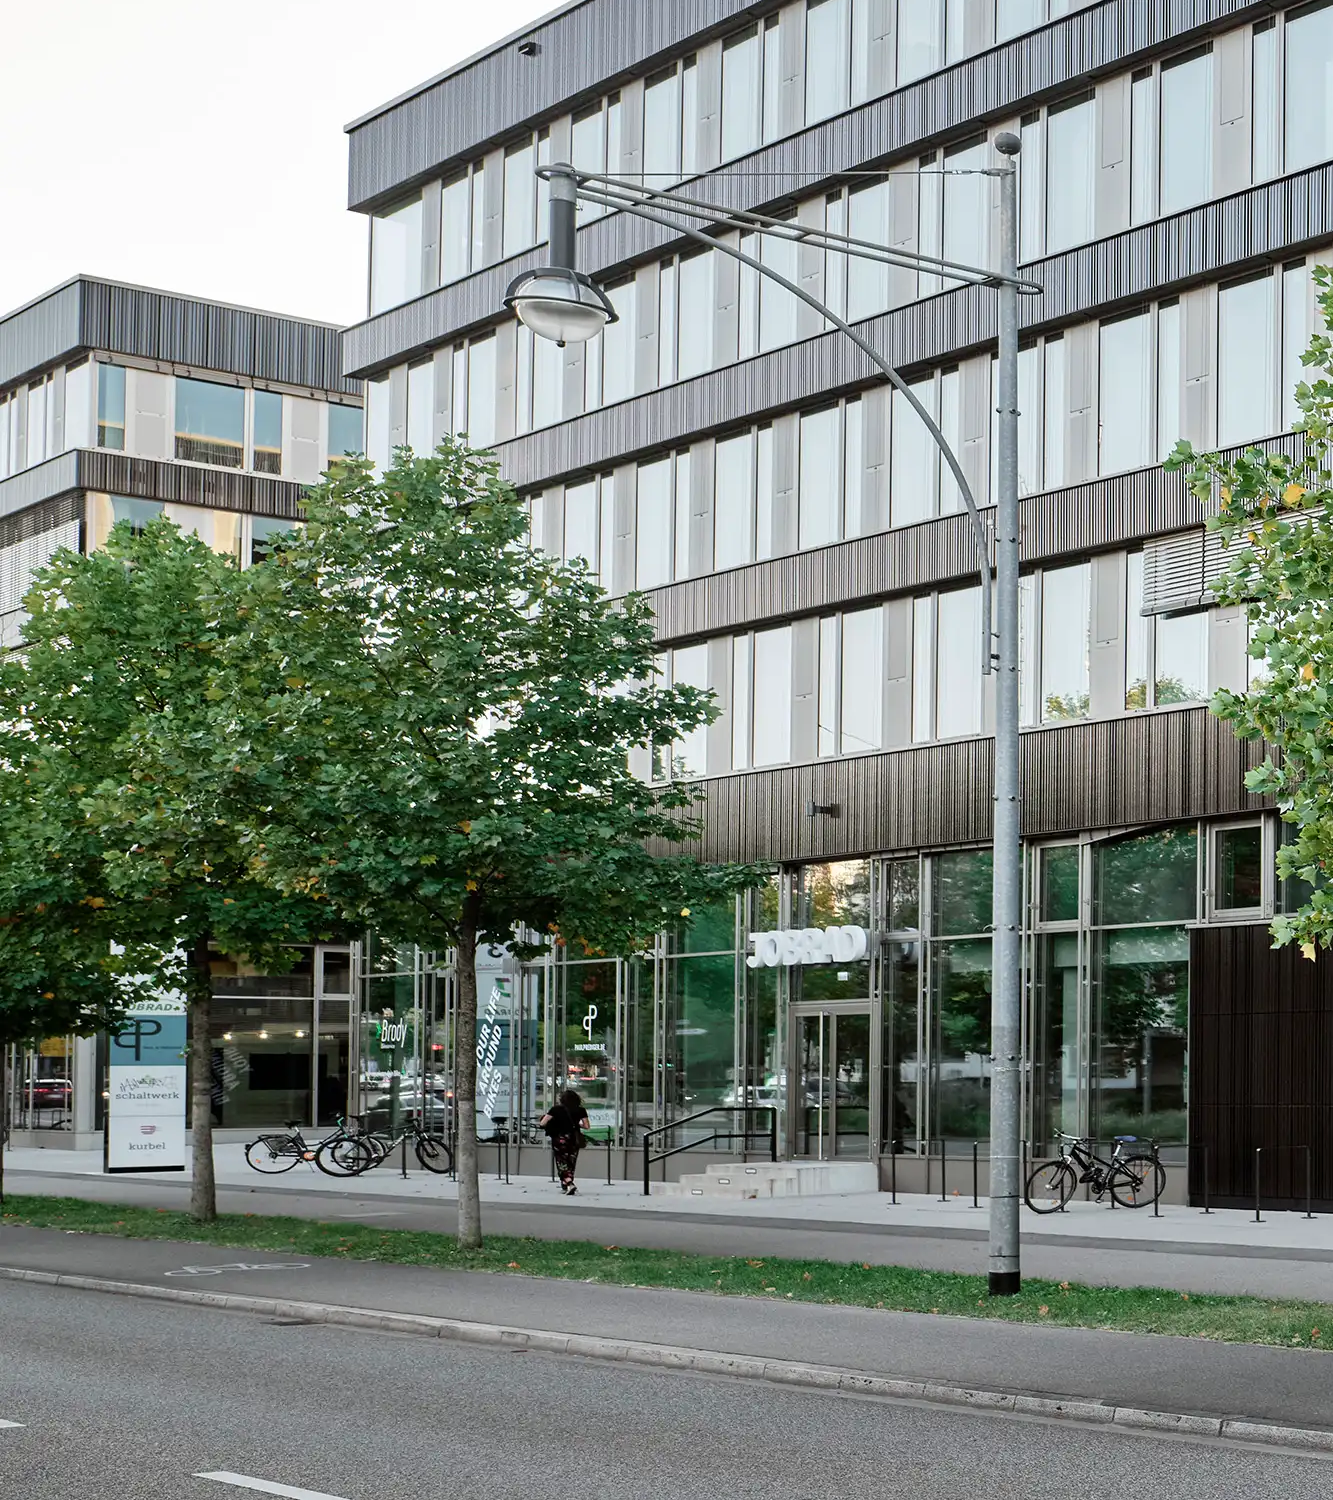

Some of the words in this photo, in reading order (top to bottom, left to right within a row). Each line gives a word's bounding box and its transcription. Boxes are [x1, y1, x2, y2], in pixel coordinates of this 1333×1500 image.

[746, 925, 867, 968] JOBRAD
[128, 1003, 173, 1011] OBRAD
[485, 985, 501, 1025] LIFE
[381, 1017, 408, 1048] Brody
[479, 1024, 502, 1096] AROUND
[115, 1091, 180, 1100] schaltwerk
[483, 1068, 502, 1119] BIKES
[128, 1142, 166, 1151] kurbel
